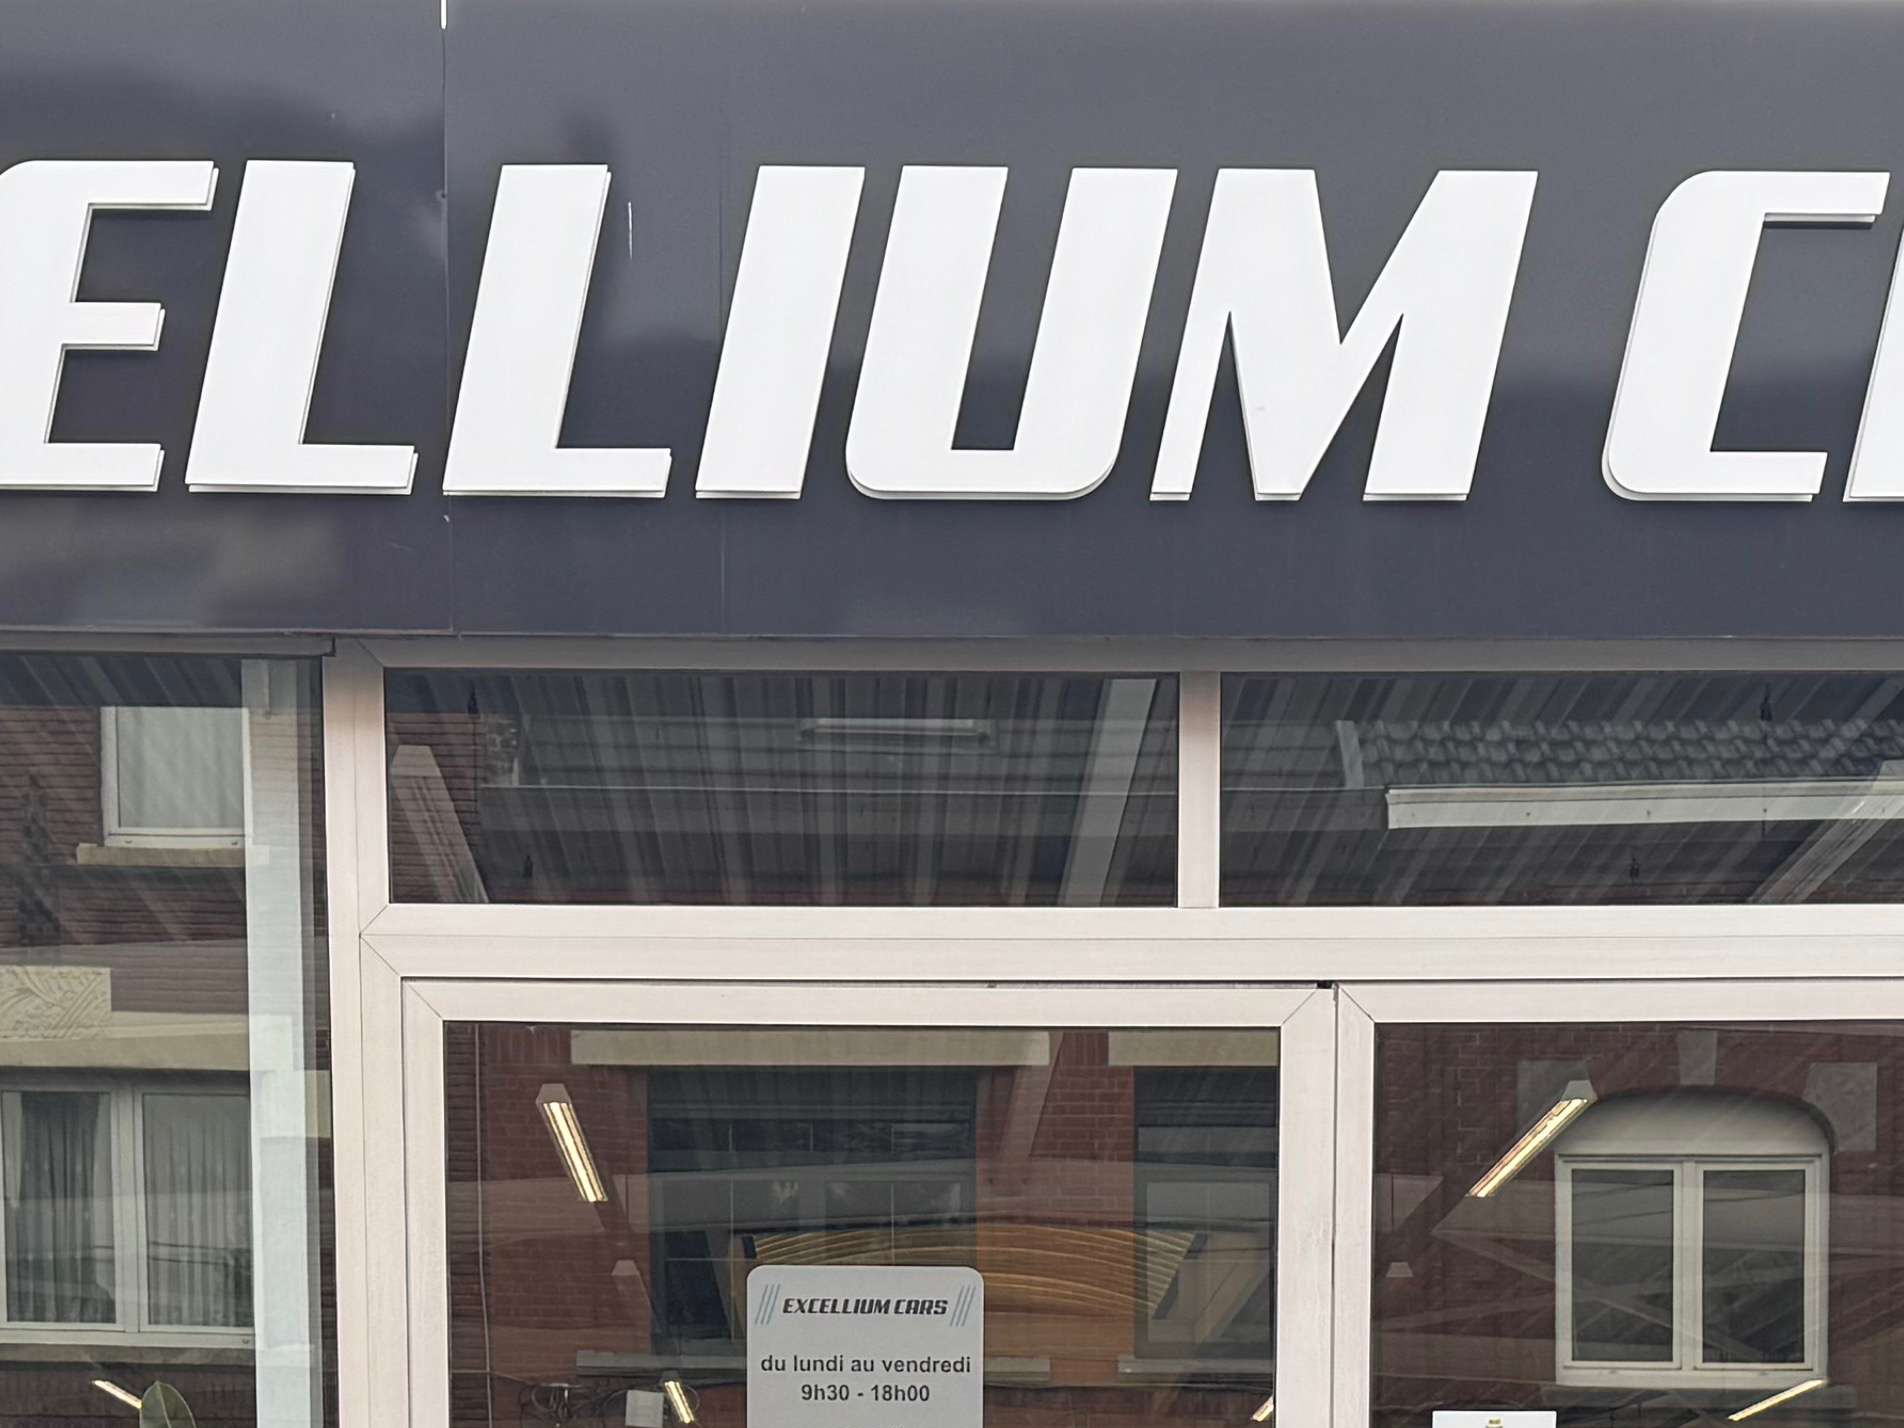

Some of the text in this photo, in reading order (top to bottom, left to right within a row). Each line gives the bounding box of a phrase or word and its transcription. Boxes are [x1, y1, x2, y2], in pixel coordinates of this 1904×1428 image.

[782, 1298, 949, 1315] EXCELLIUM CARS
[760, 1355, 971, 1373] du lundi au vendredi
[800, 1384, 850, 1401] 9h30
[870, 1385, 930, 1402] 18h00
